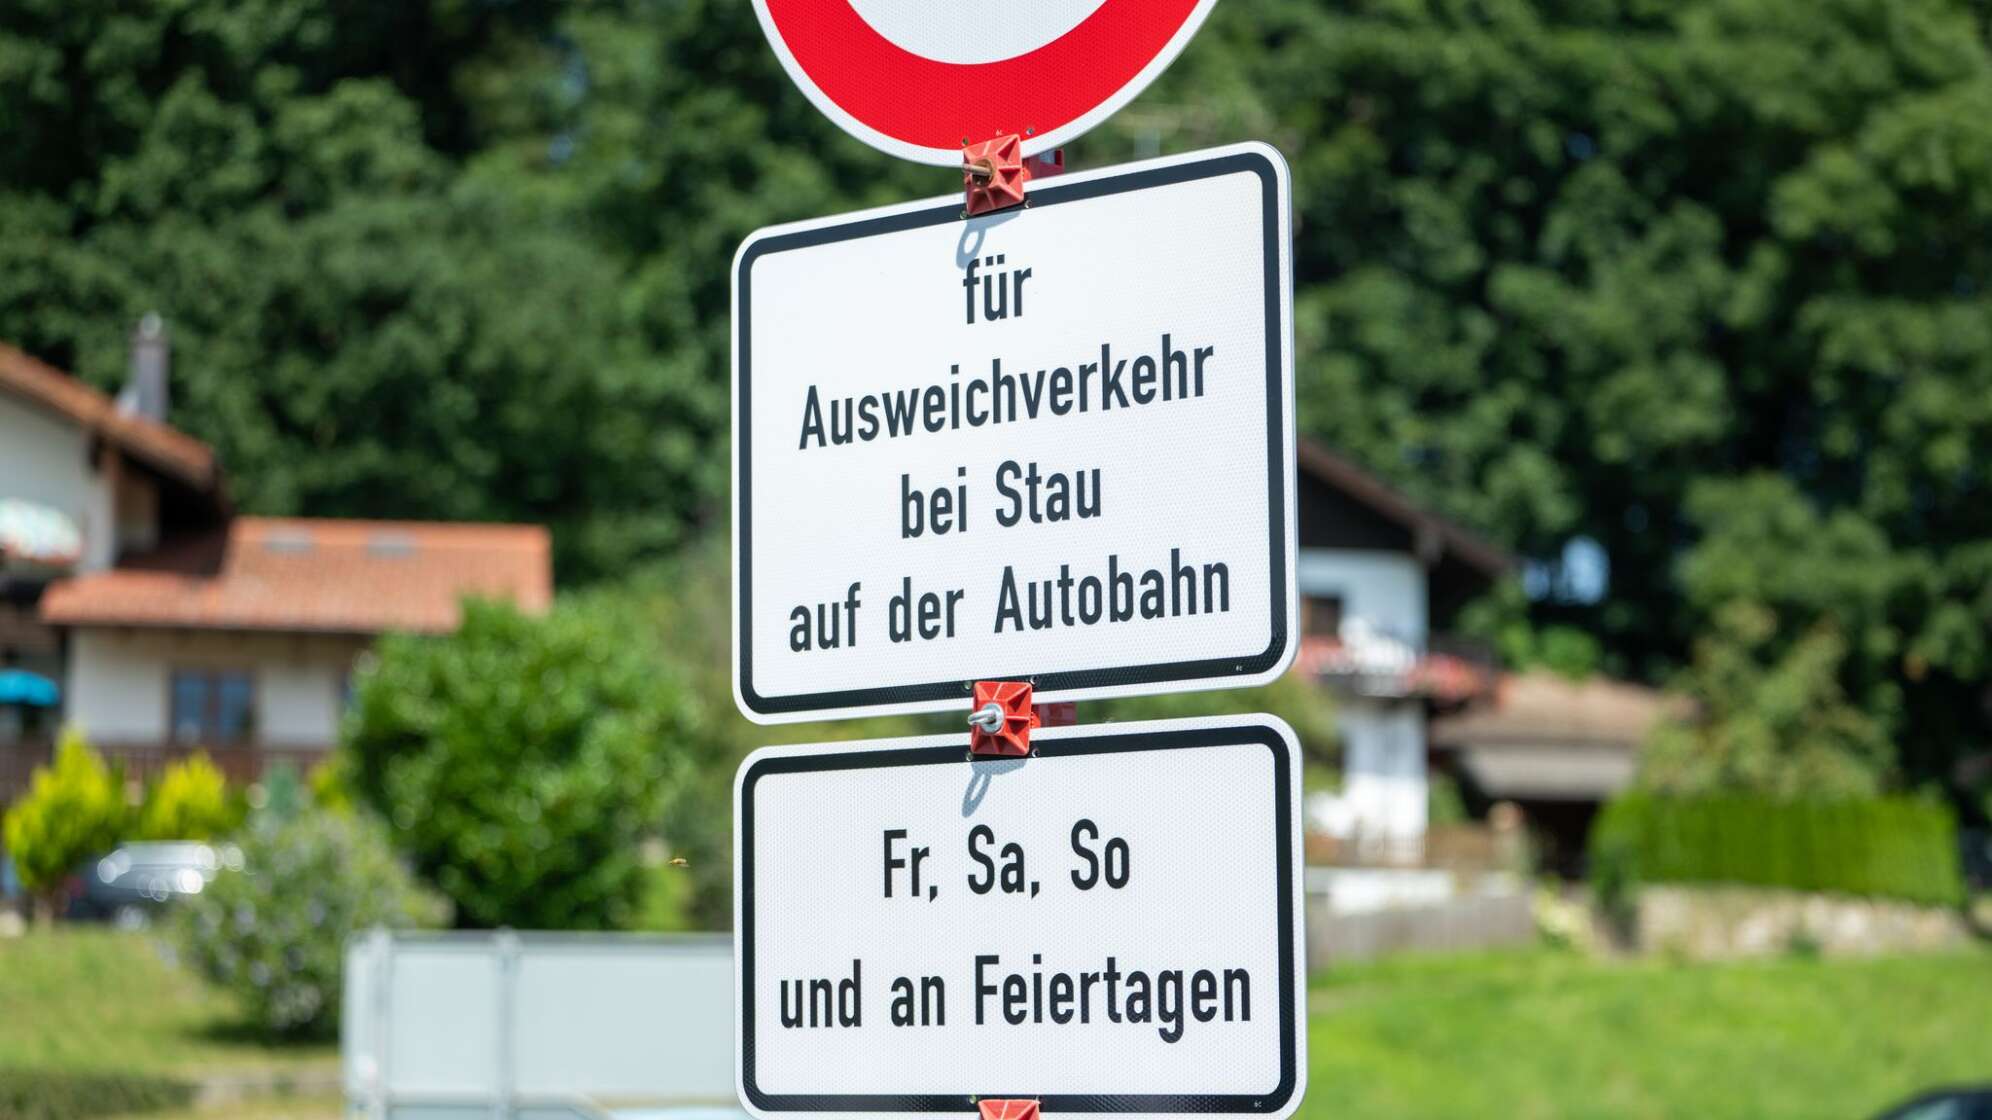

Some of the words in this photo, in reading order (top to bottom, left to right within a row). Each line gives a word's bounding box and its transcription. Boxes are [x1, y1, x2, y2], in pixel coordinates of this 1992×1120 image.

[963, 254, 1032, 325] für
[799, 333, 1214, 450] Ausweichverkehr
[901, 466, 967, 539] bei
[995, 460, 1102, 528] Stau
[789, 582, 862, 654] auf
[889, 576, 964, 643] der
[994, 548, 1232, 634] Autobahn
[883, 828, 940, 903] Fr,
[967, 823, 1041, 899] Sa,
[1070, 818, 1131, 891] So
[780, 957, 863, 1030] und
[890, 974, 946, 1028] an
[973, 953, 1252, 1044] Feiertagen
